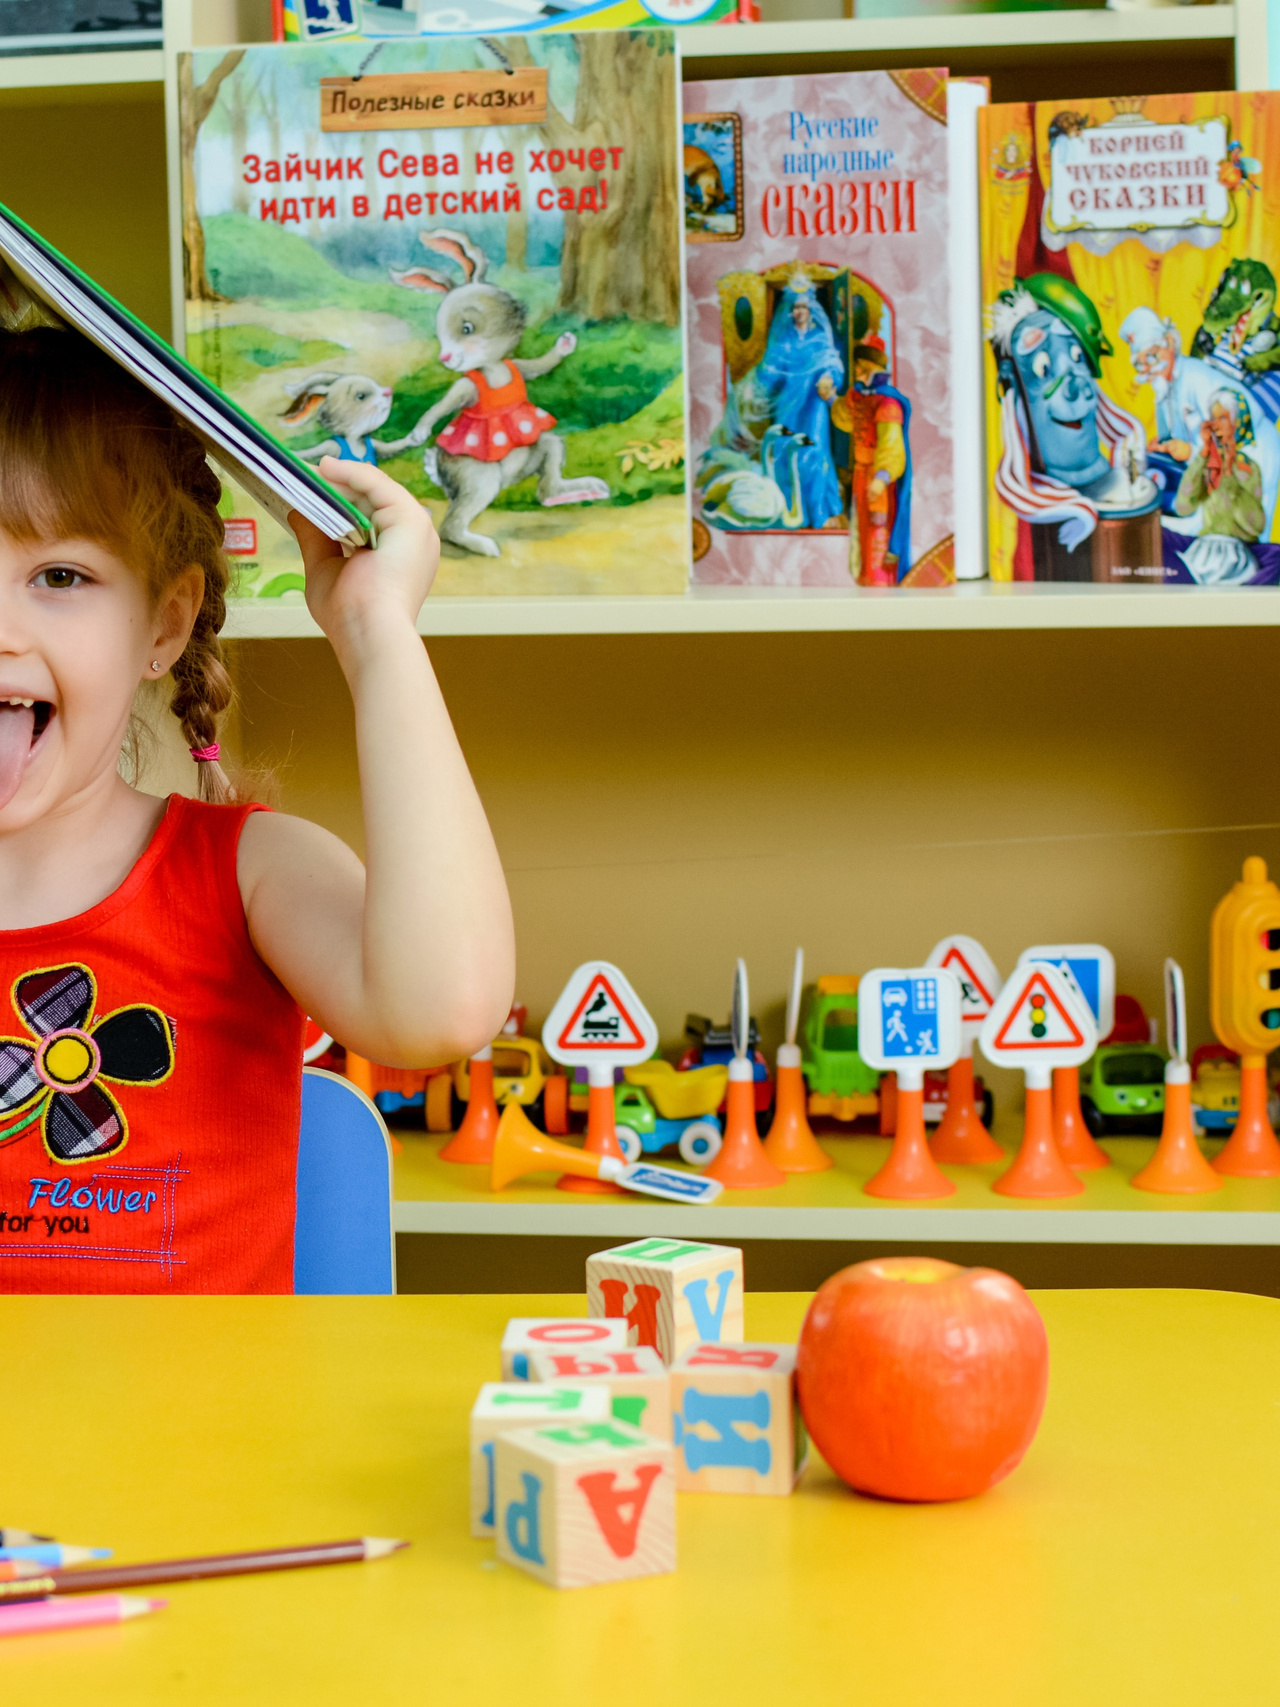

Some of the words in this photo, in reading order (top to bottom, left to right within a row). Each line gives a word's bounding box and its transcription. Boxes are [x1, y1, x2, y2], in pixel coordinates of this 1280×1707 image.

[331, 88, 446, 115] Полезные
[453, 88, 536, 110] сказки
[789, 110, 880, 150] Русские
[1088, 130, 1185, 156] КОРНЕЙ
[242, 152, 364, 184] Зайчик
[378, 148, 460, 179] Сева
[475, 149, 515, 177] не
[529, 145, 624, 174] хочет
[783, 149, 895, 182] народные
[1065, 155, 1211, 184] ЧУКОВСКИЙ
[260, 195, 337, 226] идти
[352, 192, 370, 219] в
[383, 181, 522, 222] детский
[536, 179, 609, 215] сад!
[760, 180, 918, 239] сказки
[1068, 183, 1208, 212] СКАЗКИ
[27, 1177, 157, 1214] Flower
[42, 1214, 90, 1238] you
